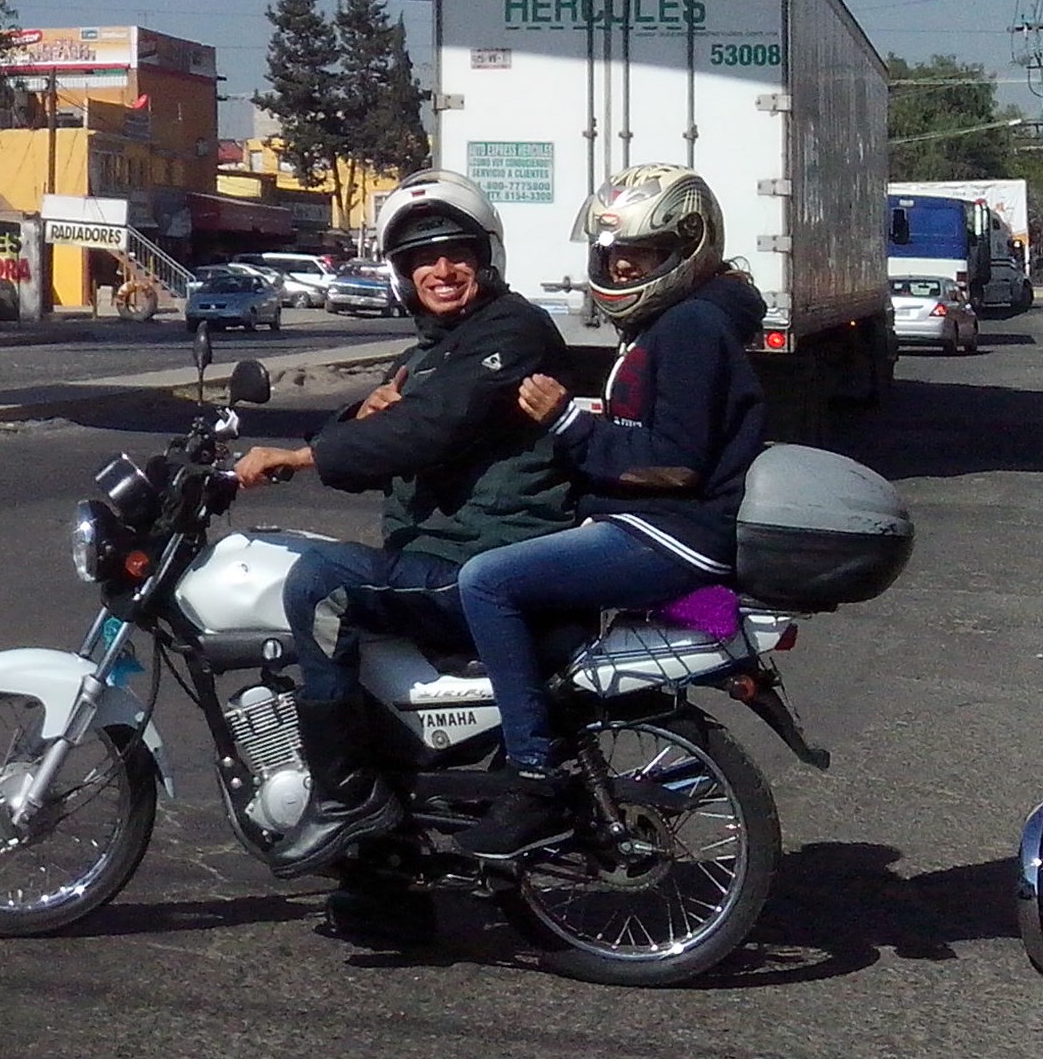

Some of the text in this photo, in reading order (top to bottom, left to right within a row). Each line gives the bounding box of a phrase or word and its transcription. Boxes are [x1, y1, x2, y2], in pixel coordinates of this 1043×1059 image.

[710, 43, 781, 66] 53008
[51, 225, 122, 244] RADIADORES
[419, 711, 477, 728] YAMAHA
